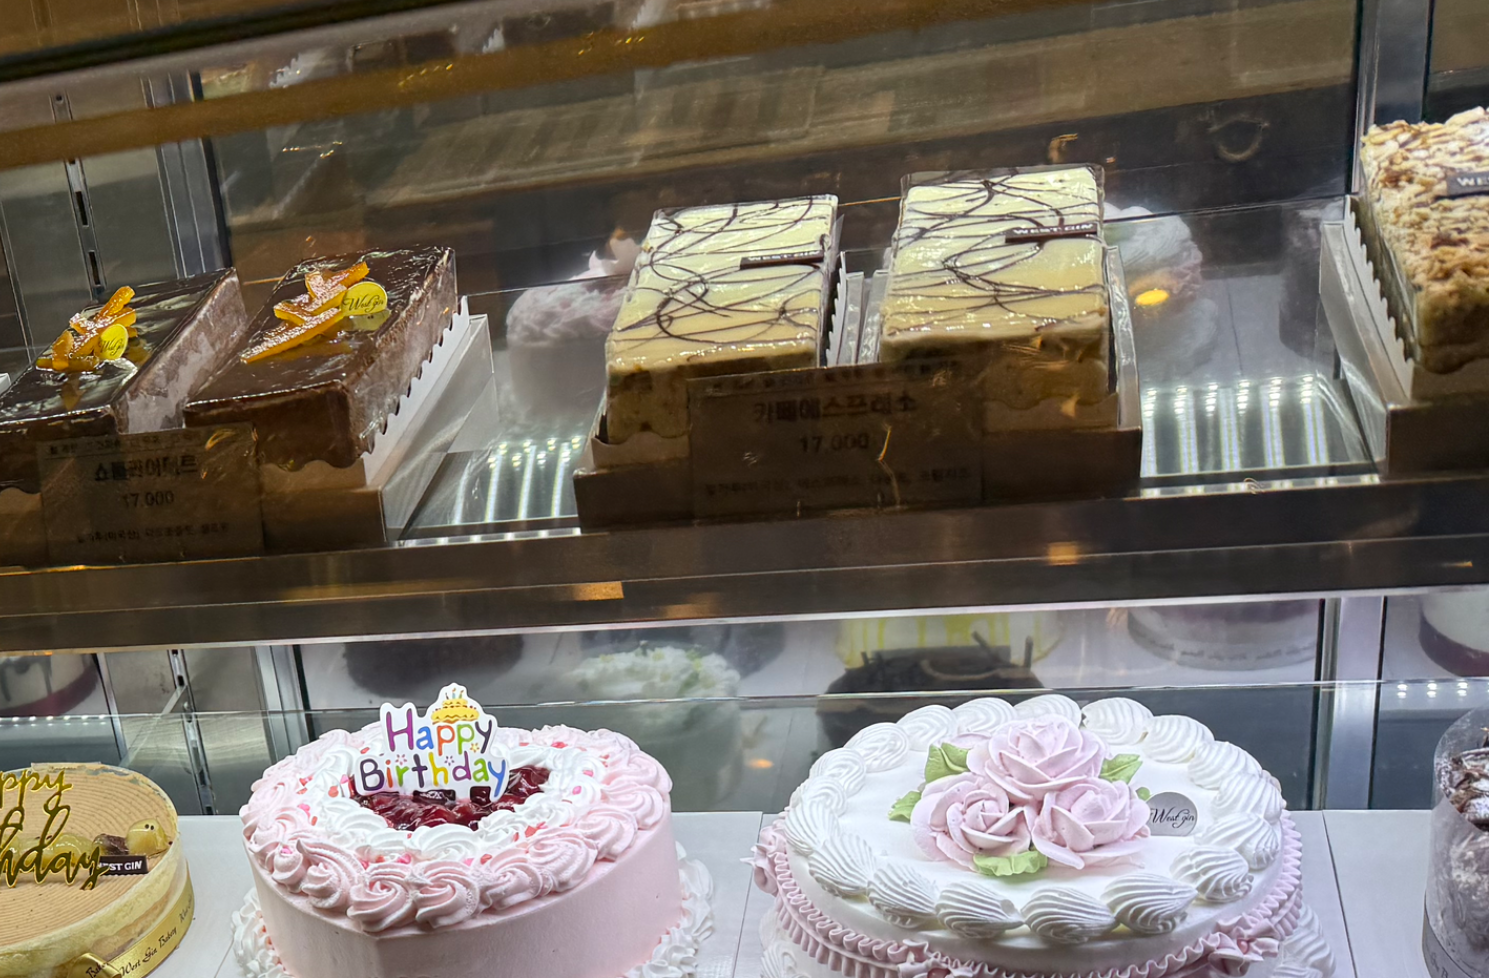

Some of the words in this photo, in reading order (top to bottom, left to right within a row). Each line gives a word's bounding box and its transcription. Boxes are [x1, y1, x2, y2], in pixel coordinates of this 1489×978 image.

[754, 391, 916, 423] 카페에스프레소
[121, 489, 176, 508] 17,000
[386, 708, 493, 757] Happy
[360, 750, 507, 798] Birthday
[123, 859, 143, 871] GIN
